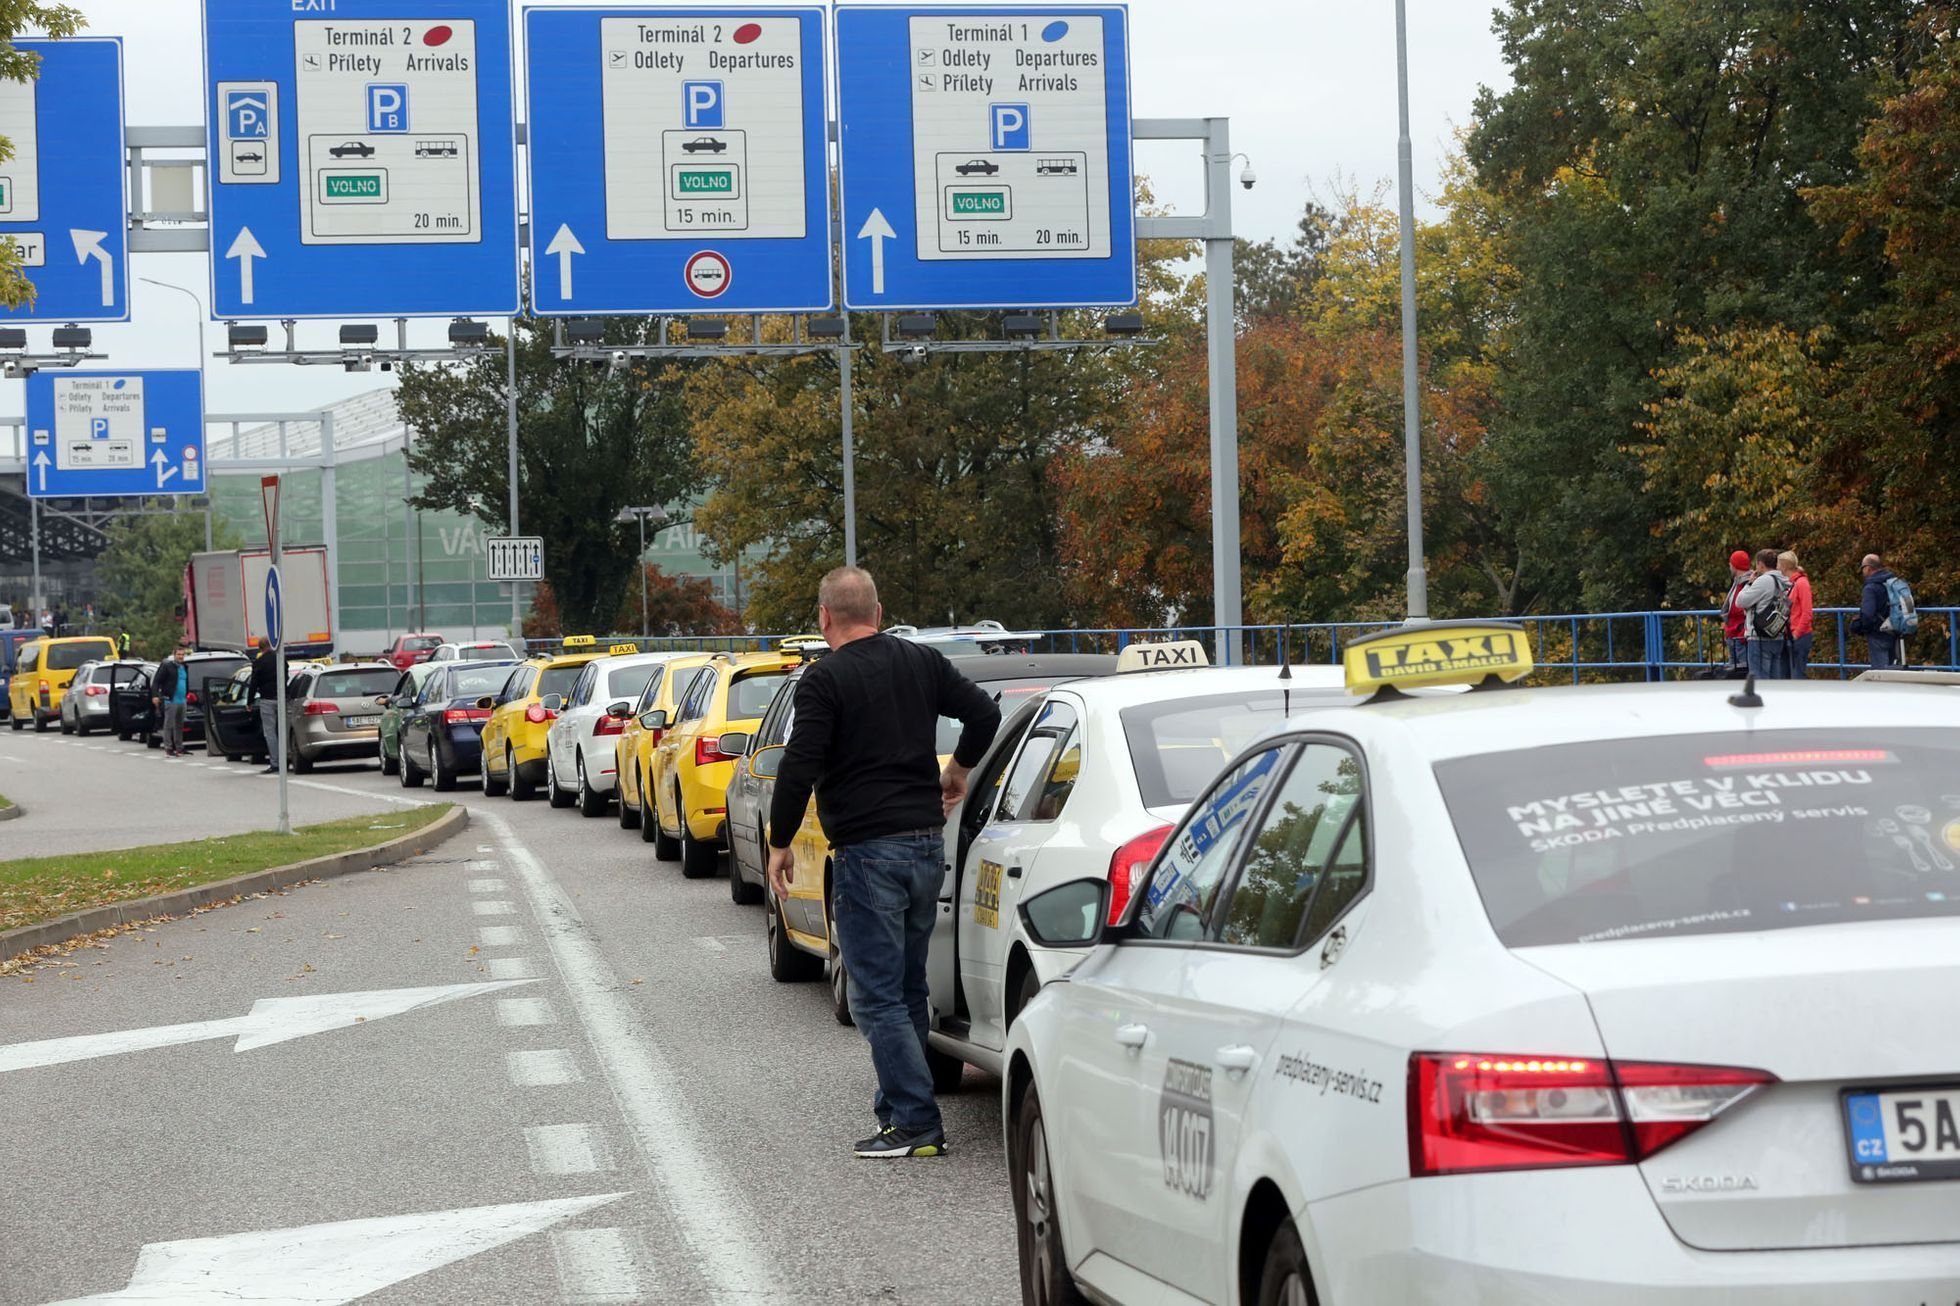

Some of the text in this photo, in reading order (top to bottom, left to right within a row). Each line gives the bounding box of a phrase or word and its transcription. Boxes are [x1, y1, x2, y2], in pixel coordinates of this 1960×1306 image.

[292, 0, 336, 11] EXIT
[325, 27, 412, 45] Terminál 2
[638, 25, 722, 43] Terminál 2
[947, 24, 1028, 42] Terminál 1
[329, 53, 468, 76] Přílety Arrivals
[635, 51, 794, 73] Odlety Departures
[943, 49, 1098, 71] Odlety Departures
[944, 74, 1077, 95] Přílety Arrivals
[373, 89, 401, 128] P
[689, 85, 717, 124] P
[239, 110, 256, 133] P
[997, 108, 1023, 146] P
[331, 180, 377, 192] VOLNO
[684, 176, 728, 188] VOLNO
[958, 197, 1000, 209] VOLNO
[414, 213, 463, 228] 20 min.
[678, 208, 736, 223] 15 min.
[958, 230, 1002, 244] 15 min.
[1036, 229, 1082, 244] 20 min.
[102, 392, 140, 402] Departures
[103, 404, 130, 412] Arrivals
[94, 420, 106, 437] P
[665, 522, 704, 549] AI
[613, 645, 635, 653] TAXI
[1137, 648, 1196, 665] TAXI
[1368, 636, 1511, 667] TAXI
[1381, 664, 1437, 677] DAVID
[1507, 770, 1872, 822] MYSLETE V KLIDU
[1792, 805, 1868, 818] servis
[1518, 813, 1584, 837] NA
[1895, 1099, 1960, 1152] 5A
[1858, 1139, 1883, 1156] CZ
